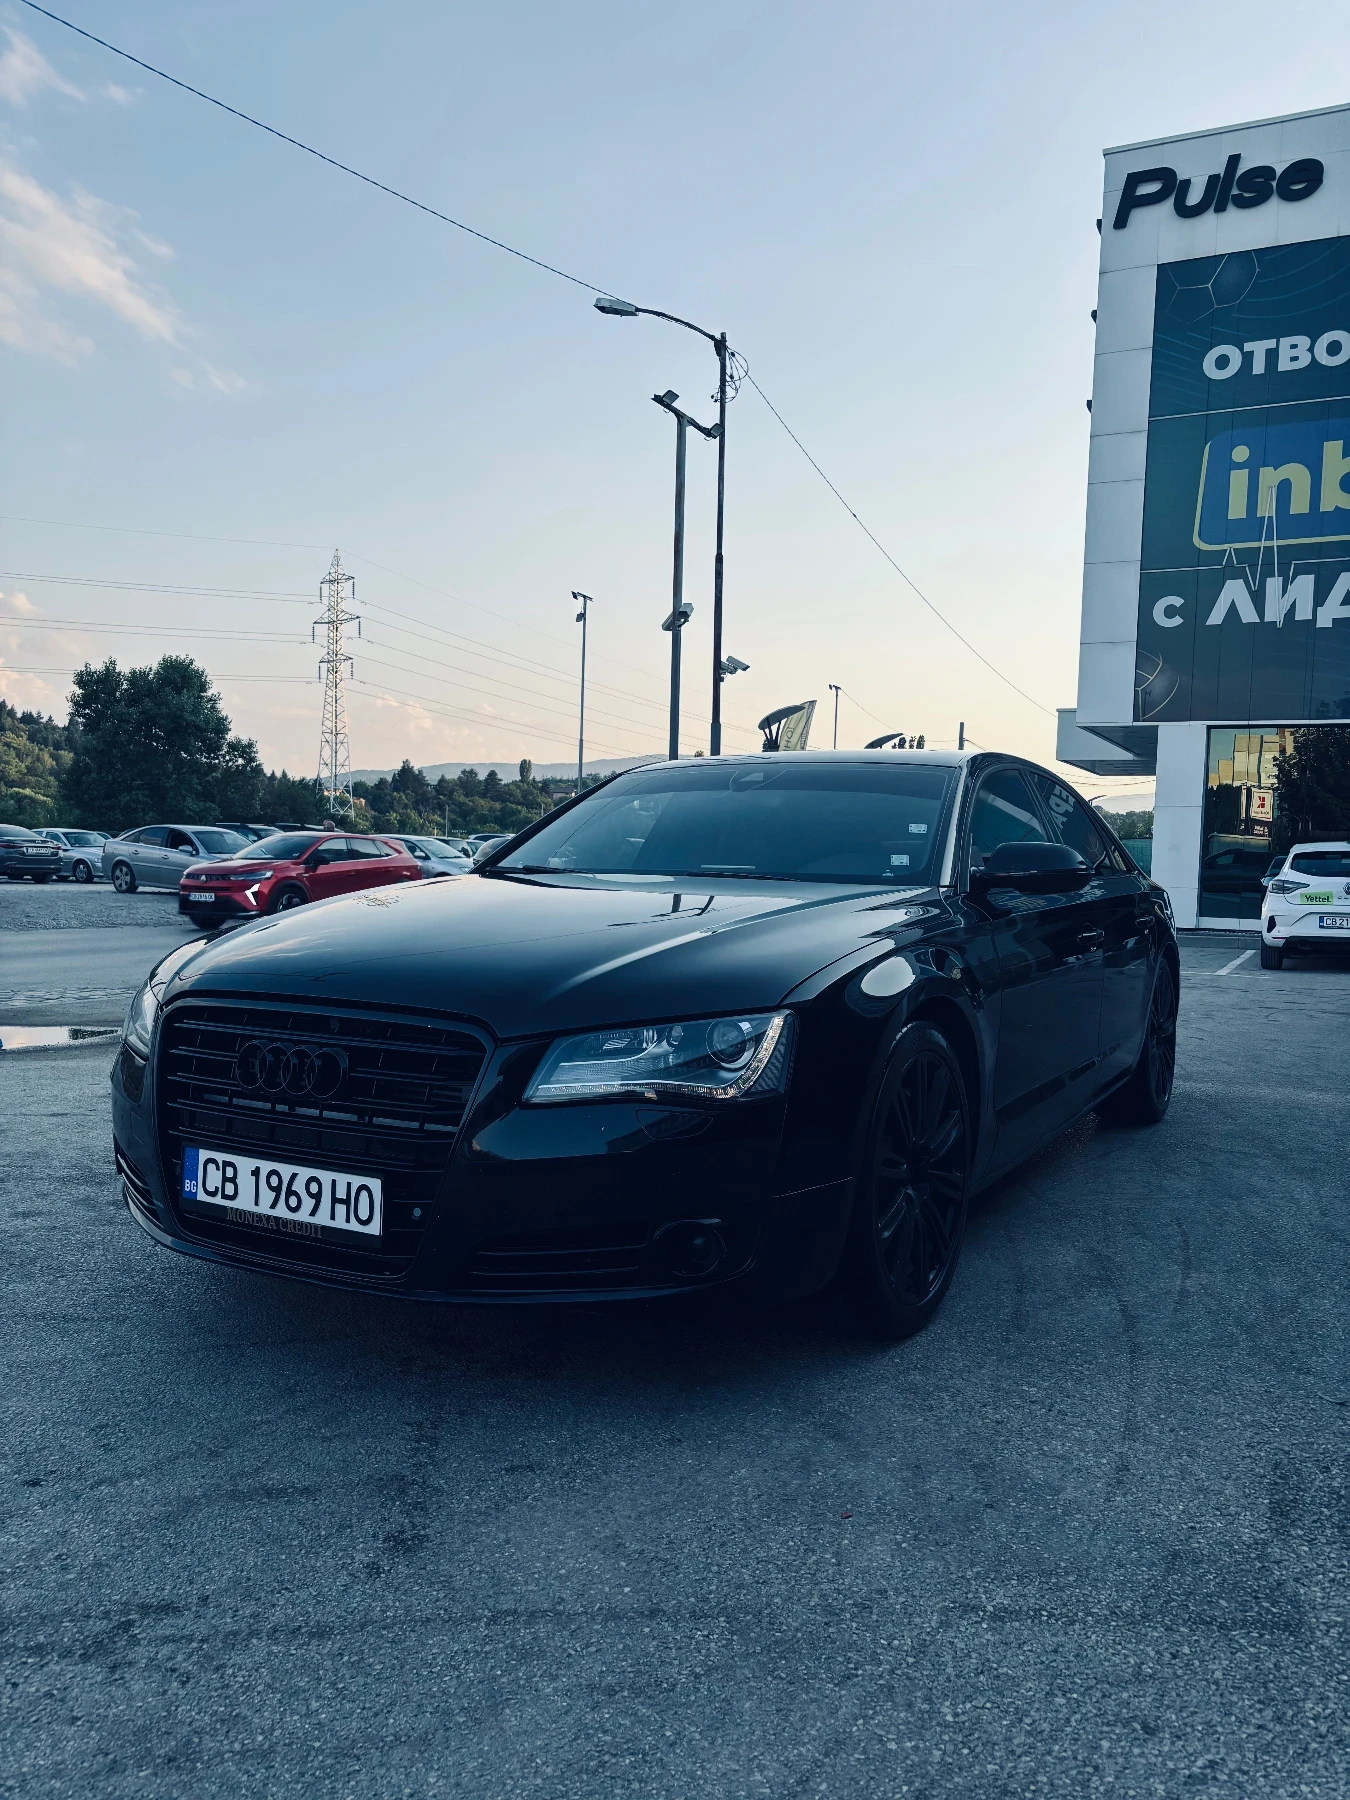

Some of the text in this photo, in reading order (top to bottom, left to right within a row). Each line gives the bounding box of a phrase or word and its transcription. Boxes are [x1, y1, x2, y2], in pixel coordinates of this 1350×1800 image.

[1113, 152, 1325, 229] Pulse
[1202, 330, 1350, 380] ОТВО
[1325, 918, 1337, 926] CB
[185, 1179, 196, 1192] BG
[202, 1157, 375, 1226] CB 1969 HO
[226, 1206, 324, 1239] MONEXA CREDIT
